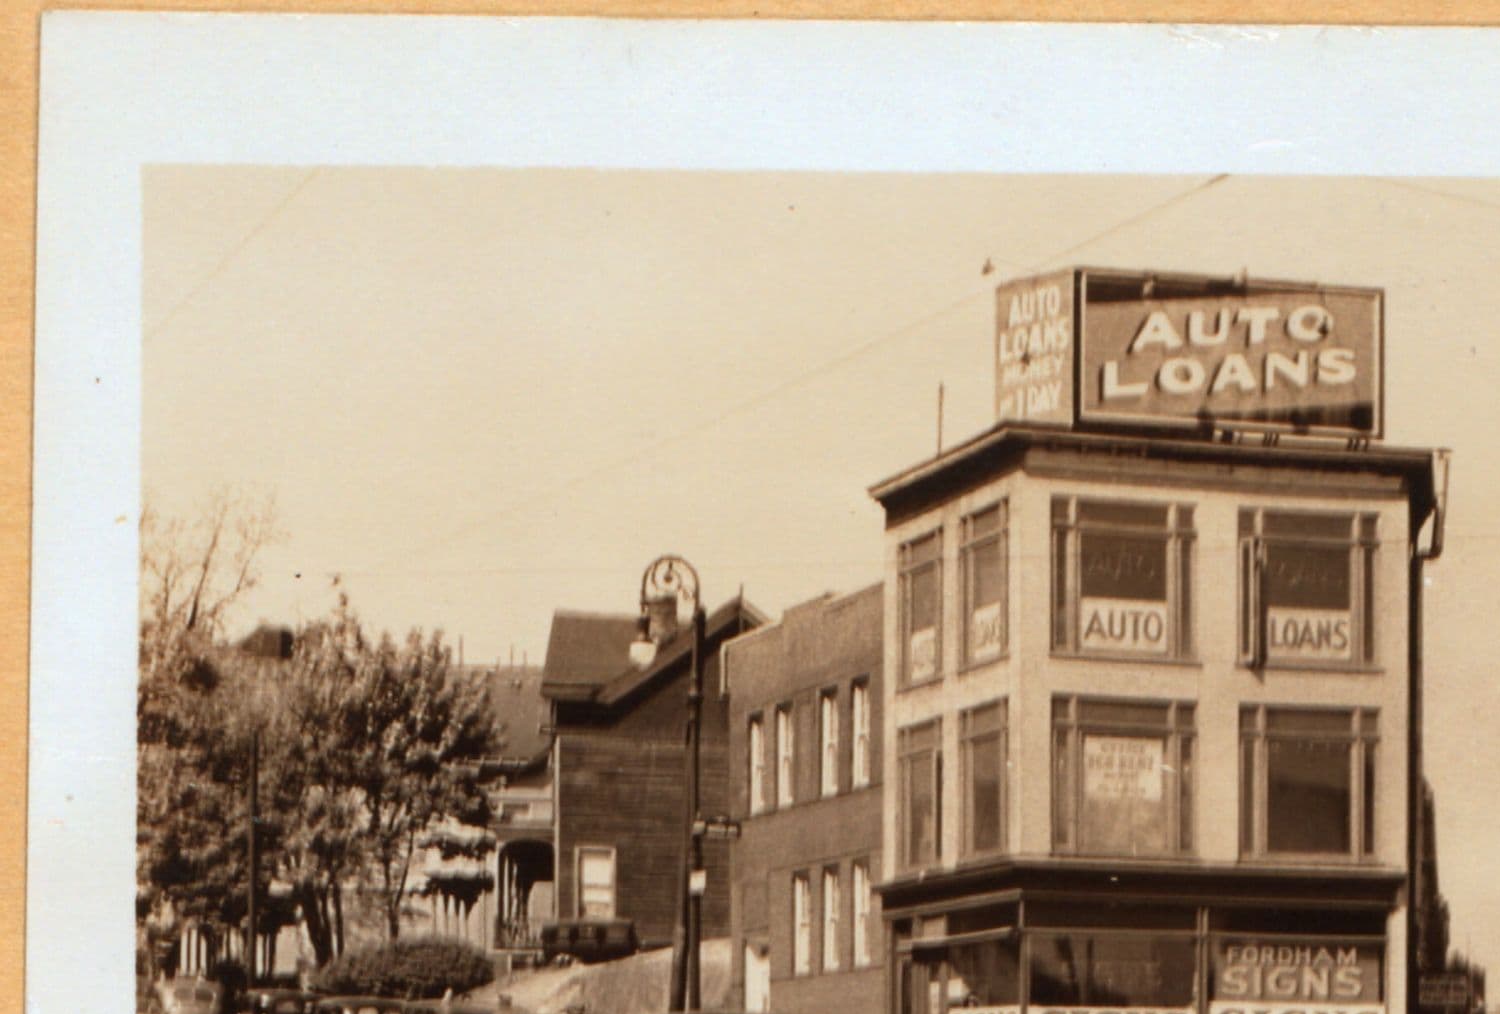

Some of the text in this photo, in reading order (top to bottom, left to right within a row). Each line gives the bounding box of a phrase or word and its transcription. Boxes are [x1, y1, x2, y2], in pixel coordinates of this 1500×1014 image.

[1009, 285, 1061, 328] AUTO
[1000, 319, 1069, 364] LOANS
[1129, 304, 1334, 353] AUTO
[1101, 347, 1357, 400] LOANS
[1027, 380, 1062, 416] DAY
[1084, 608, 1164, 642] AUTO
[1269, 617, 1348, 650] LOANS
[1226, 945, 1358, 968] FORDHAM
[1220, 965, 1362, 998] SIGNS
